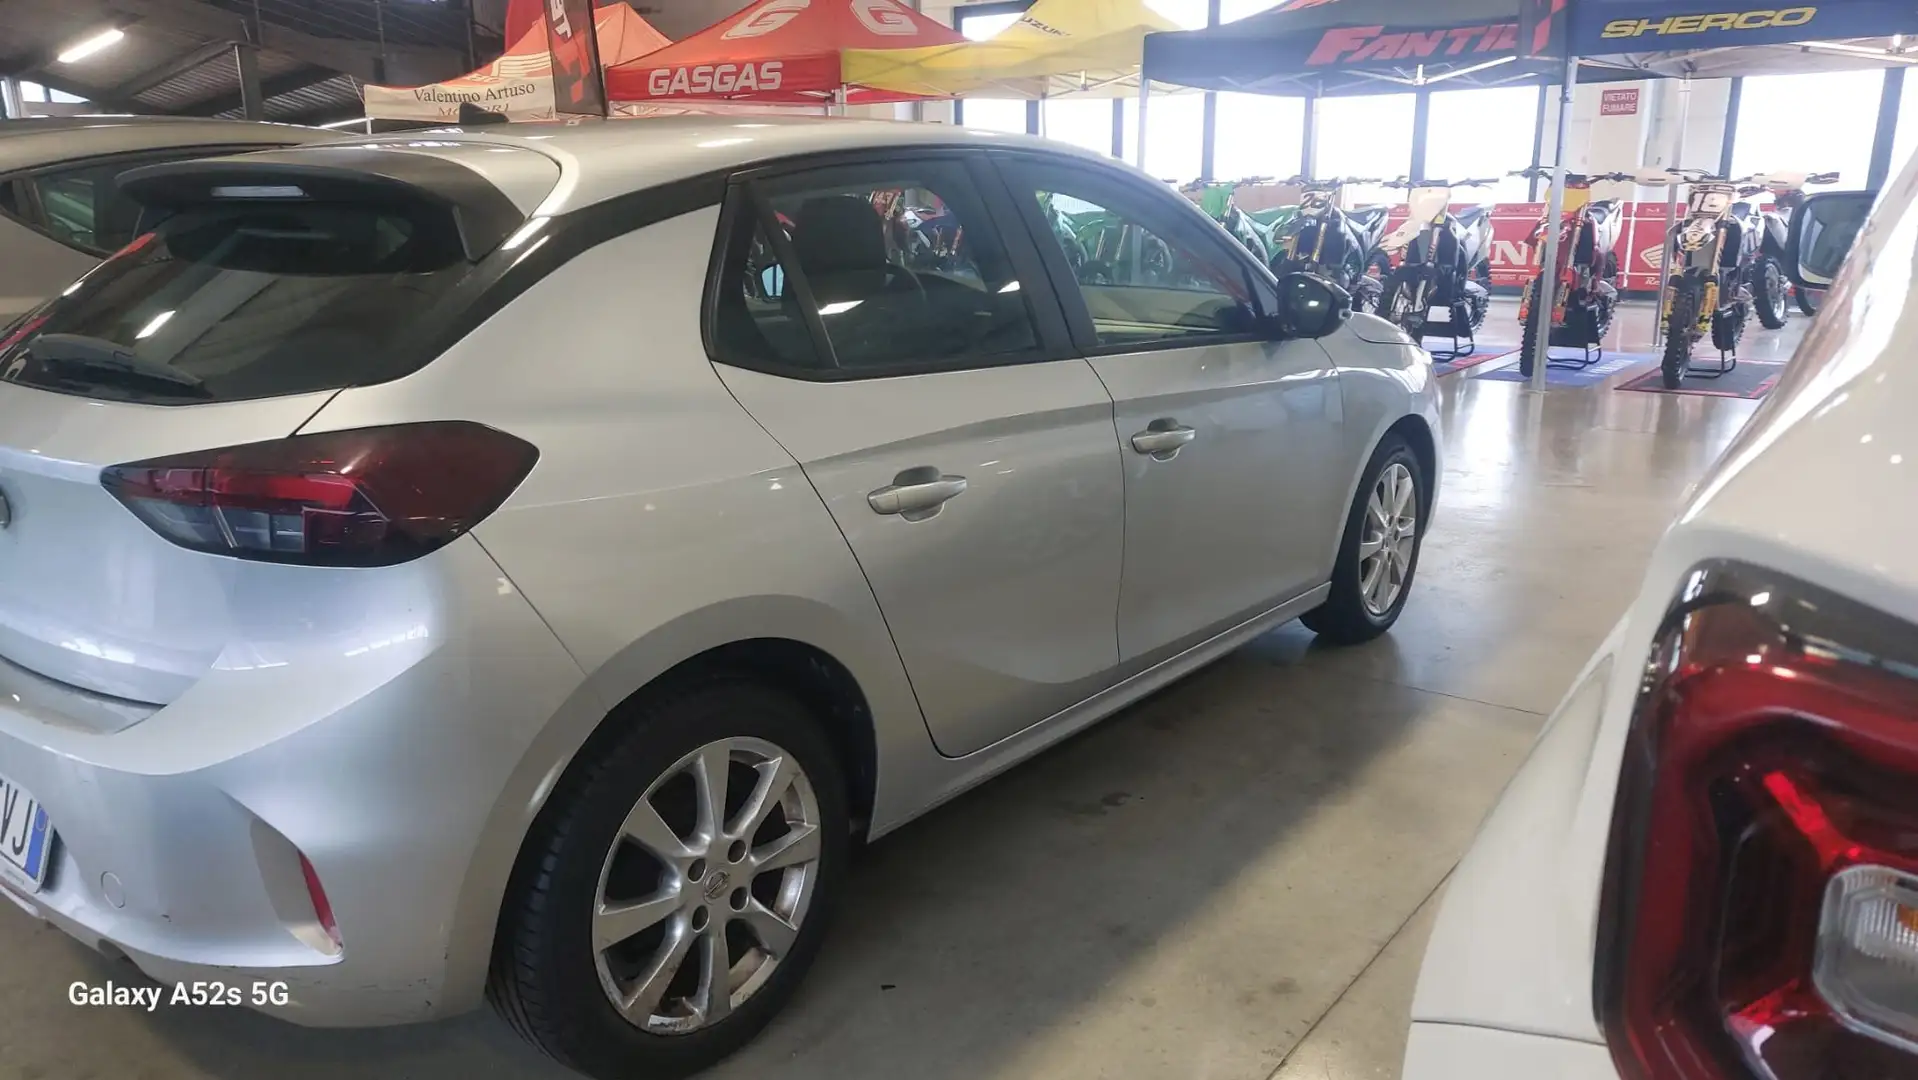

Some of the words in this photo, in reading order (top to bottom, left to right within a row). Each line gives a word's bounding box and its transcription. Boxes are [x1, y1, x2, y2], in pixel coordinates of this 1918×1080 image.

[1601, 7, 1818, 38] SHERCO
[649, 61, 783, 95] GASGAS
[413, 88, 481, 103] Valentino
[485, 83, 535, 101] Artuso
[1604, 92, 1637, 102] VIETATO
[1602, 103, 1636, 113] FUMARE
[0, 778, 34, 856] VJ
